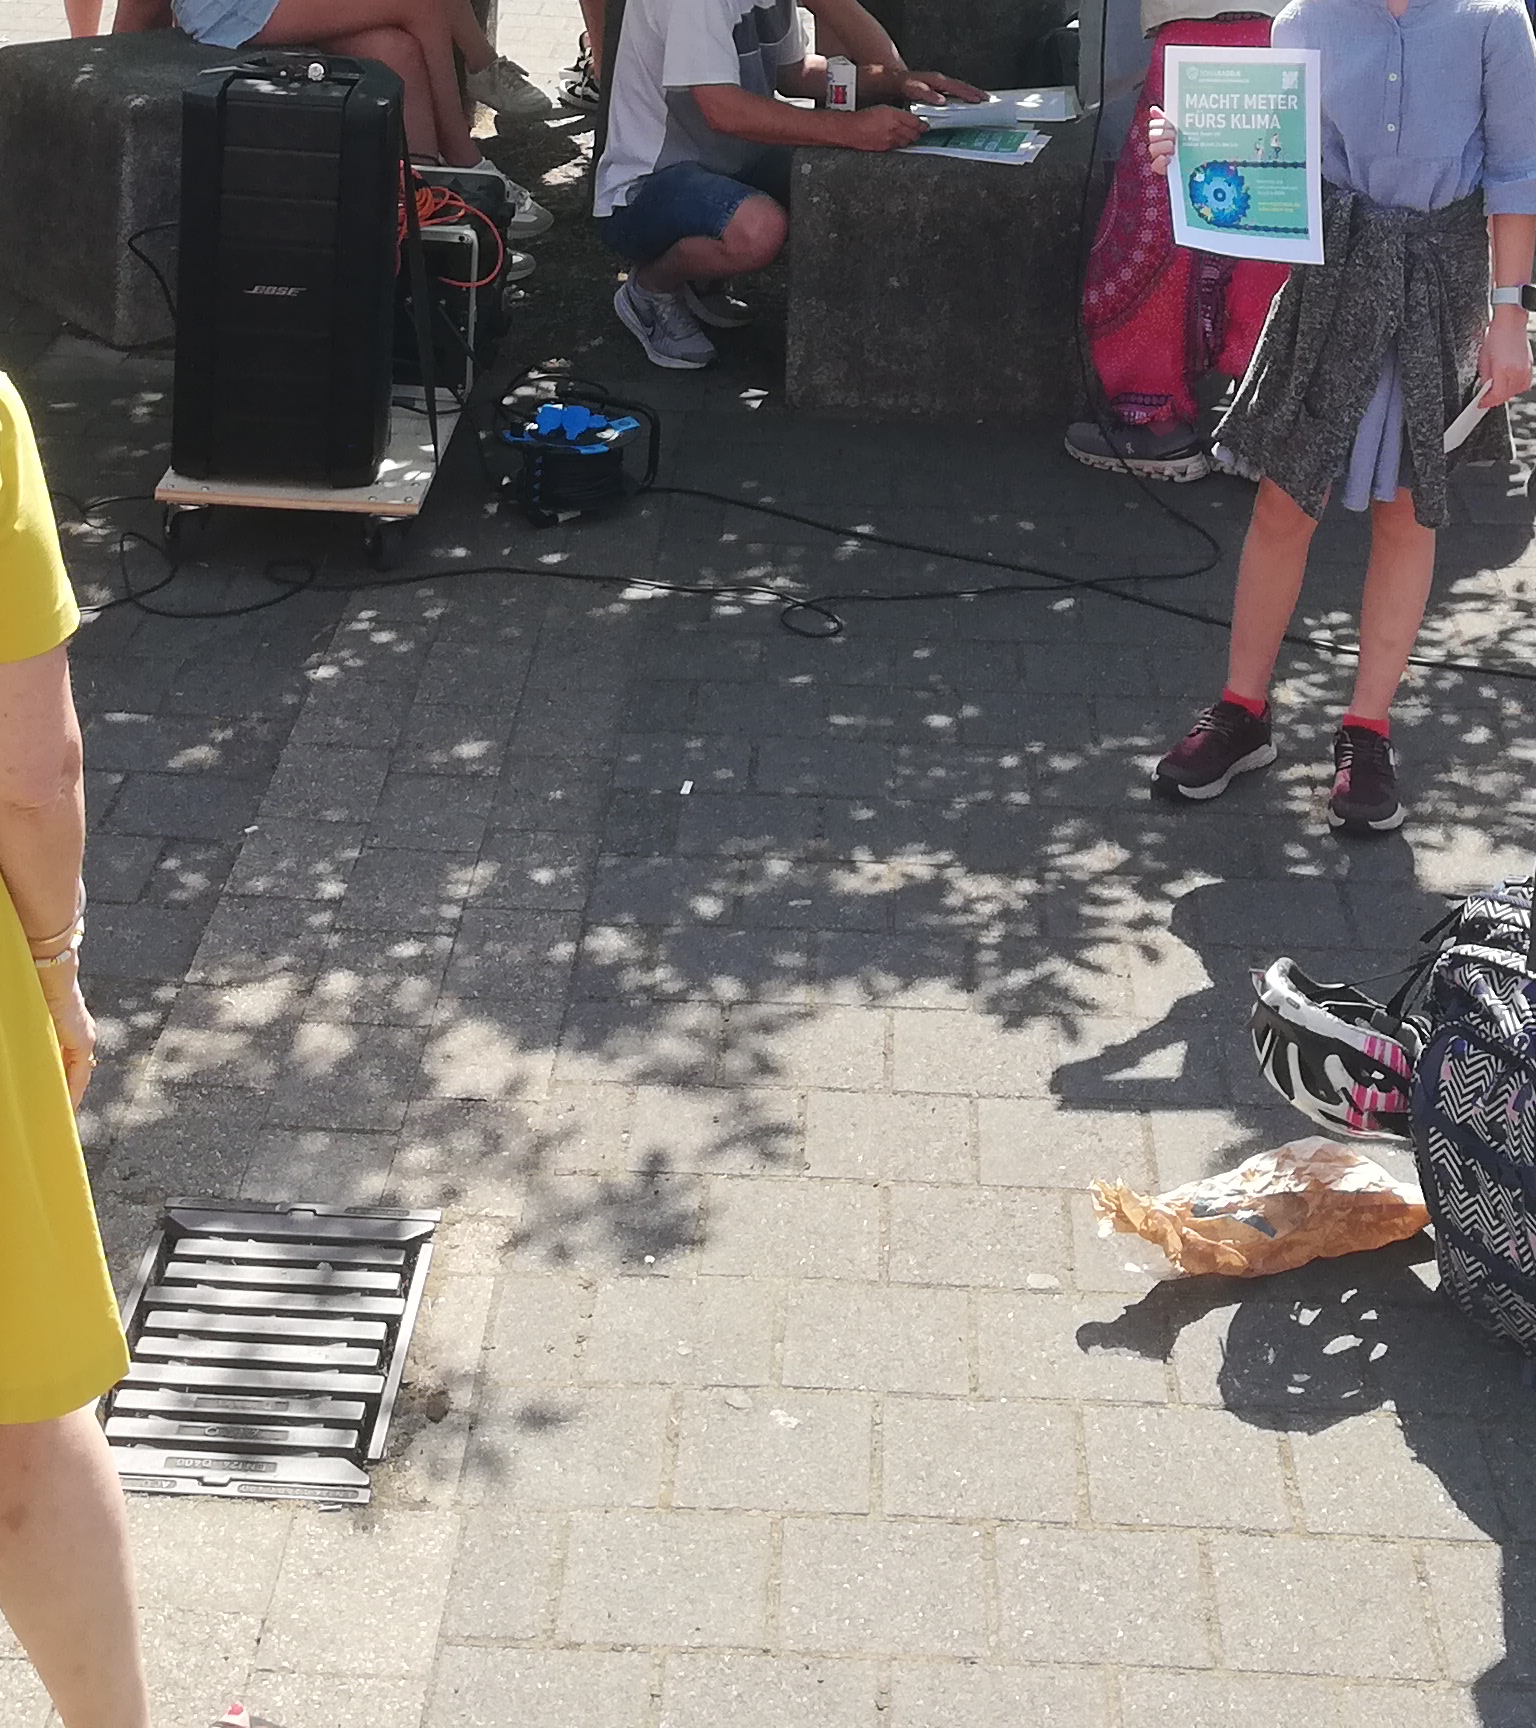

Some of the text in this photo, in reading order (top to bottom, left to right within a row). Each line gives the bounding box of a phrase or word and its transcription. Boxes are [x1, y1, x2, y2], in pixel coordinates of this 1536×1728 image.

[1185, 93, 1299, 110] MACHT METER
[1185, 110, 1282, 130] FÜRS KLIMA
[242, 285, 307, 297] BOSE
